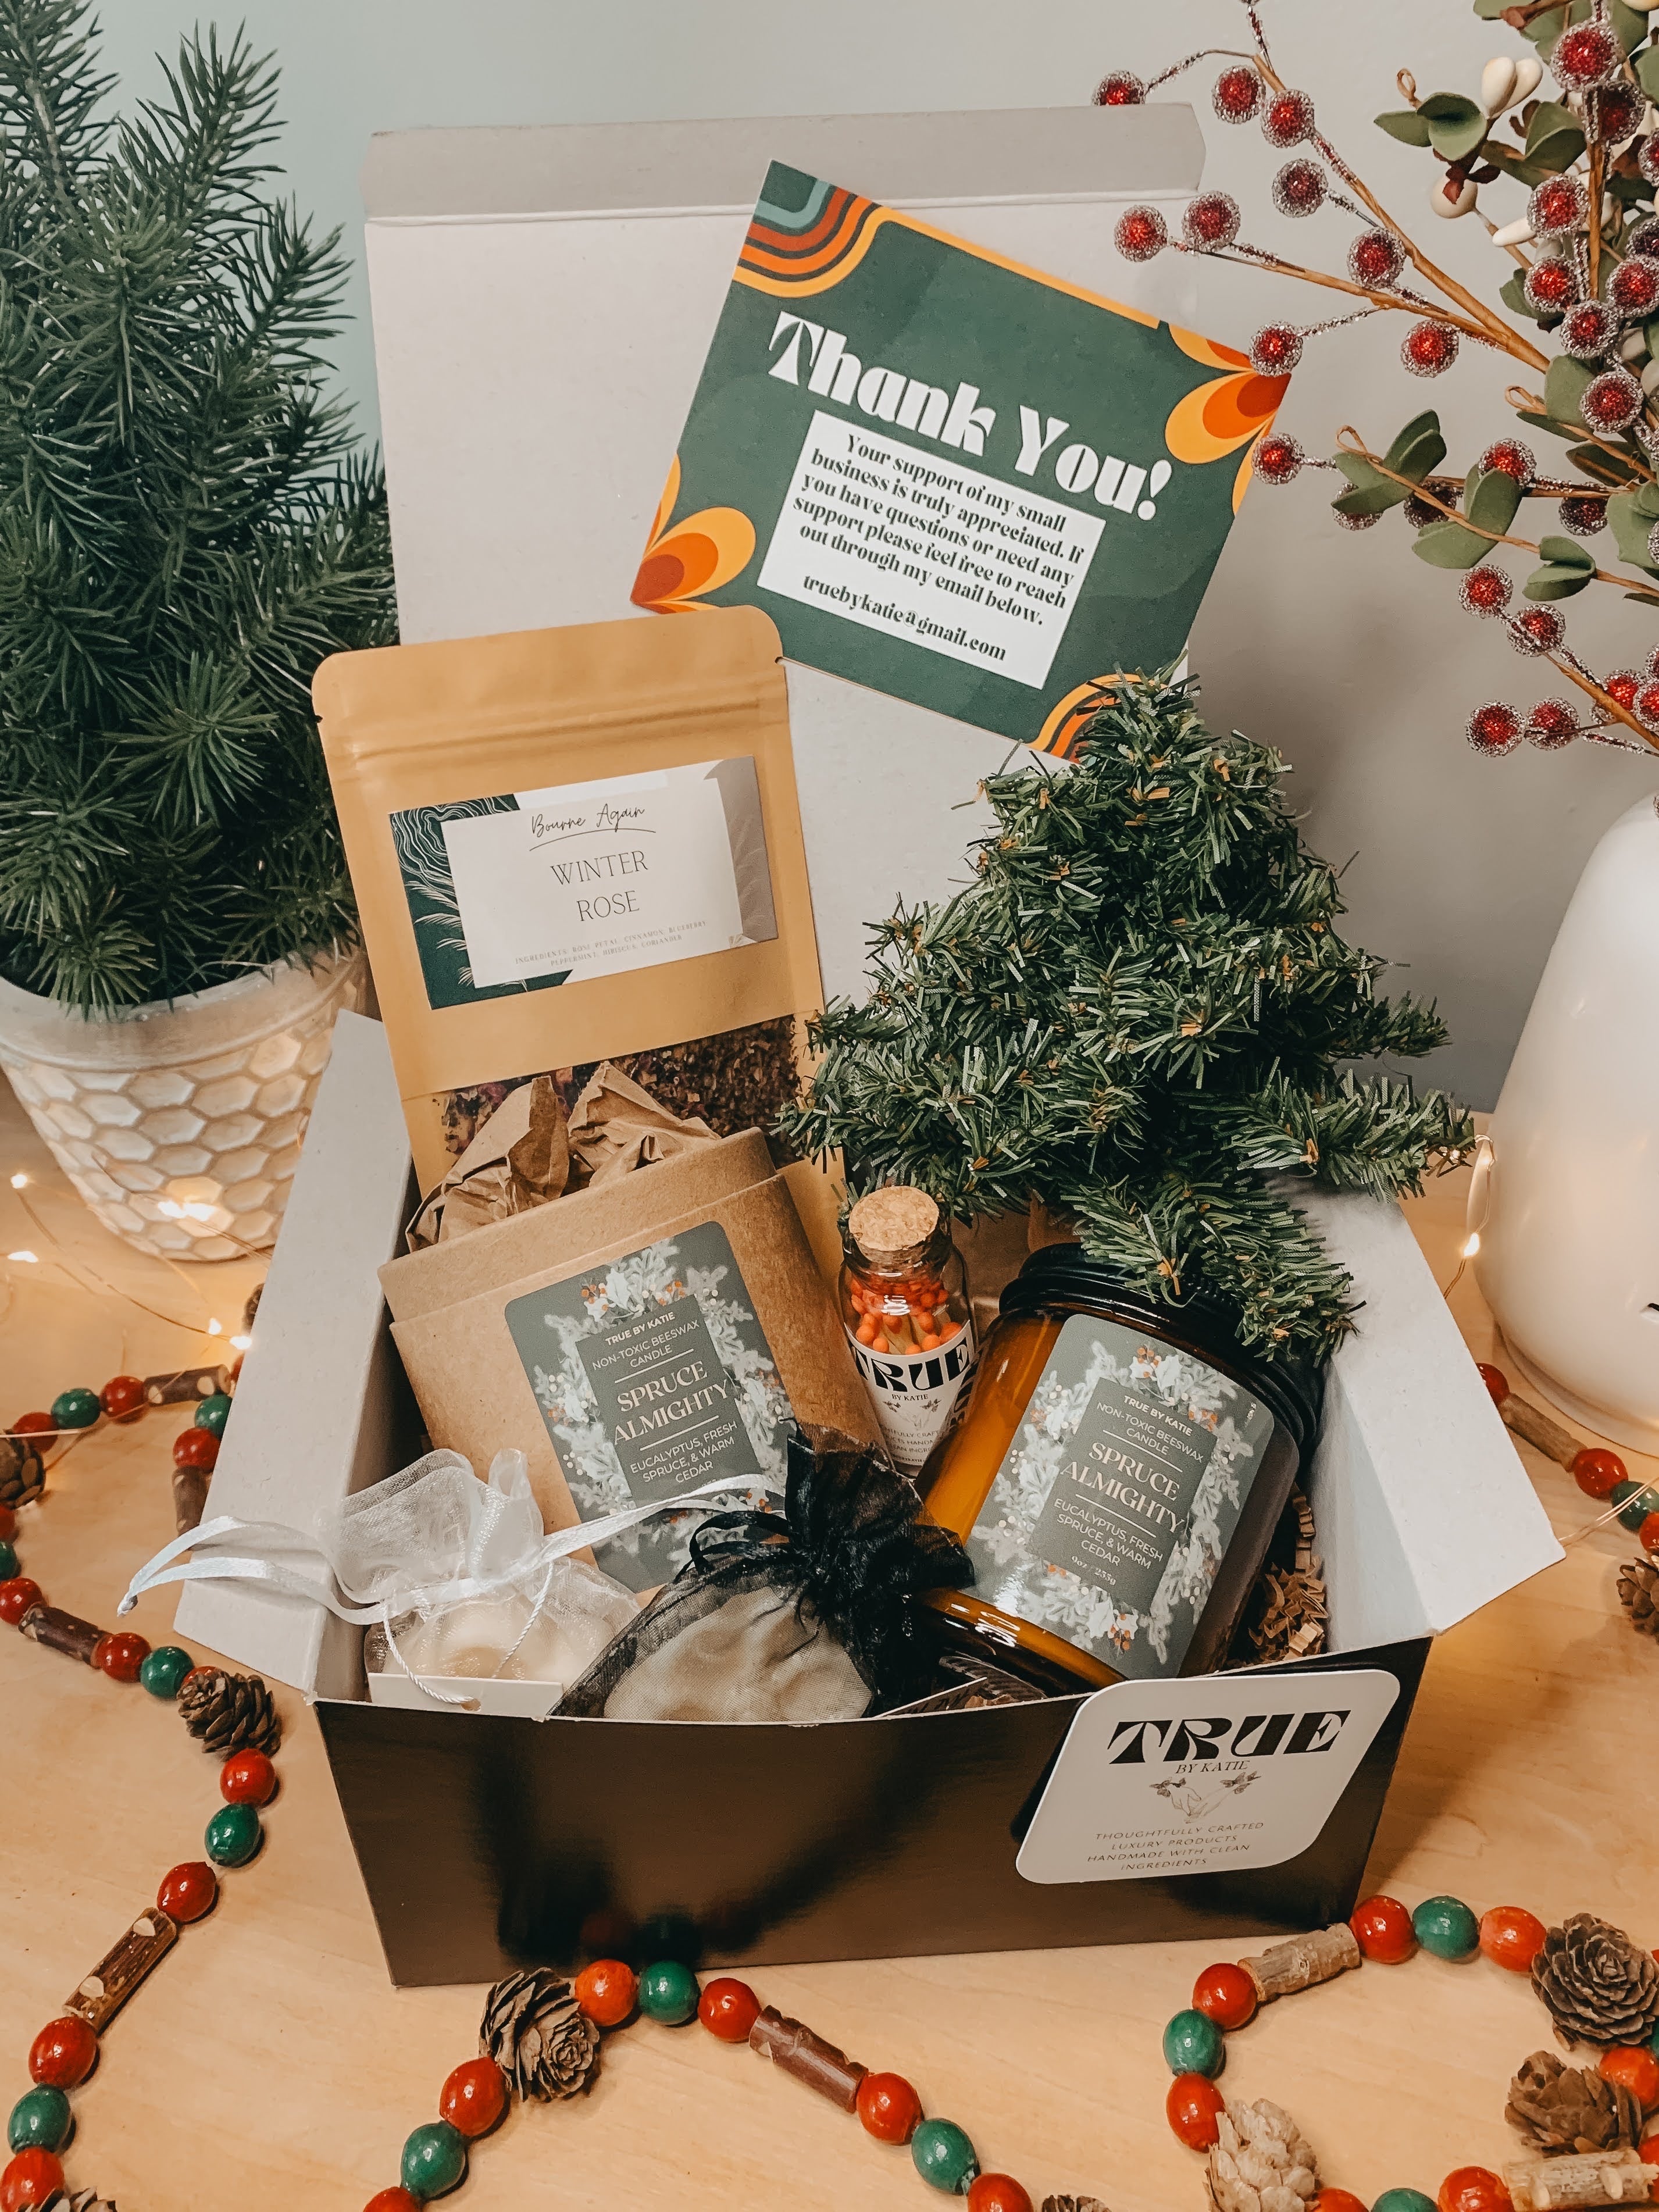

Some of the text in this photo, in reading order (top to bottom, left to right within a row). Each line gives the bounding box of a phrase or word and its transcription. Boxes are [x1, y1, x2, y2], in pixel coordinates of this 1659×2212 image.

[768, 311, 1172, 521] Thank You!
[811, 448, 1084, 564] business is truly appreciated. If
[848, 433, 1066, 533] Your support of my small
[793, 497, 1066, 609] support please feel free to reach
[801, 474, 1075, 588] you have questions or need any
[800, 525, 1043, 626] out through my email below.
[803, 576, 1006, 661] truebykatie@gmail.com
[532, 804, 645, 837] Bourne Again
[550, 850, 648, 885] WINTER
[576, 890, 640, 922] ROSE
[592, 1320, 700, 1371] NON-TOXIC BEESWAX
[605, 1312, 676, 1346] TRUE BY KATIE
[630, 1344, 673, 1367] CANDLE
[850, 1336, 970, 1393] TRUE
[614, 1379, 727, 1445] ALMIGHTY
[617, 1361, 708, 1412] SPRUCE
[1097, 1402, 1204, 1463] NON-TOXIC BEESWAX
[1124, 1396, 1193, 1436] TRUE BY KATIE
[1126, 1428, 1169, 1455] CANDLE
[630, 1421, 737, 1474] EUCALYPTUS, FRESH
[643, 1437, 735, 1482] SPRUCE, & WARM
[675, 1461, 713, 1483] CEDAR
[1089, 1442, 1180, 1501] SPRUCE
[1060, 1461, 1185, 1533] ALMIGHTY
[1054, 1498, 1163, 1562] EUCALYPTUS, FRESH
[1057, 1514, 1151, 1569] SPRUCE, & WARM
[1081, 1540, 1121, 1566] CEDAR
[1107, 1710, 1351, 1764] TRUE
[1175, 1760, 1250, 1774] BY KATIE
[1087, 1844, 1250, 1862] HANDMADE WITH CLEAN
[1096, 1822, 1264, 1840] THOUGHTFULLY CRAFTED
[1112, 1835, 1238, 1850] LUXURY PRODUCTS
[1121, 1858, 1207, 1871] INGREDIENTS
